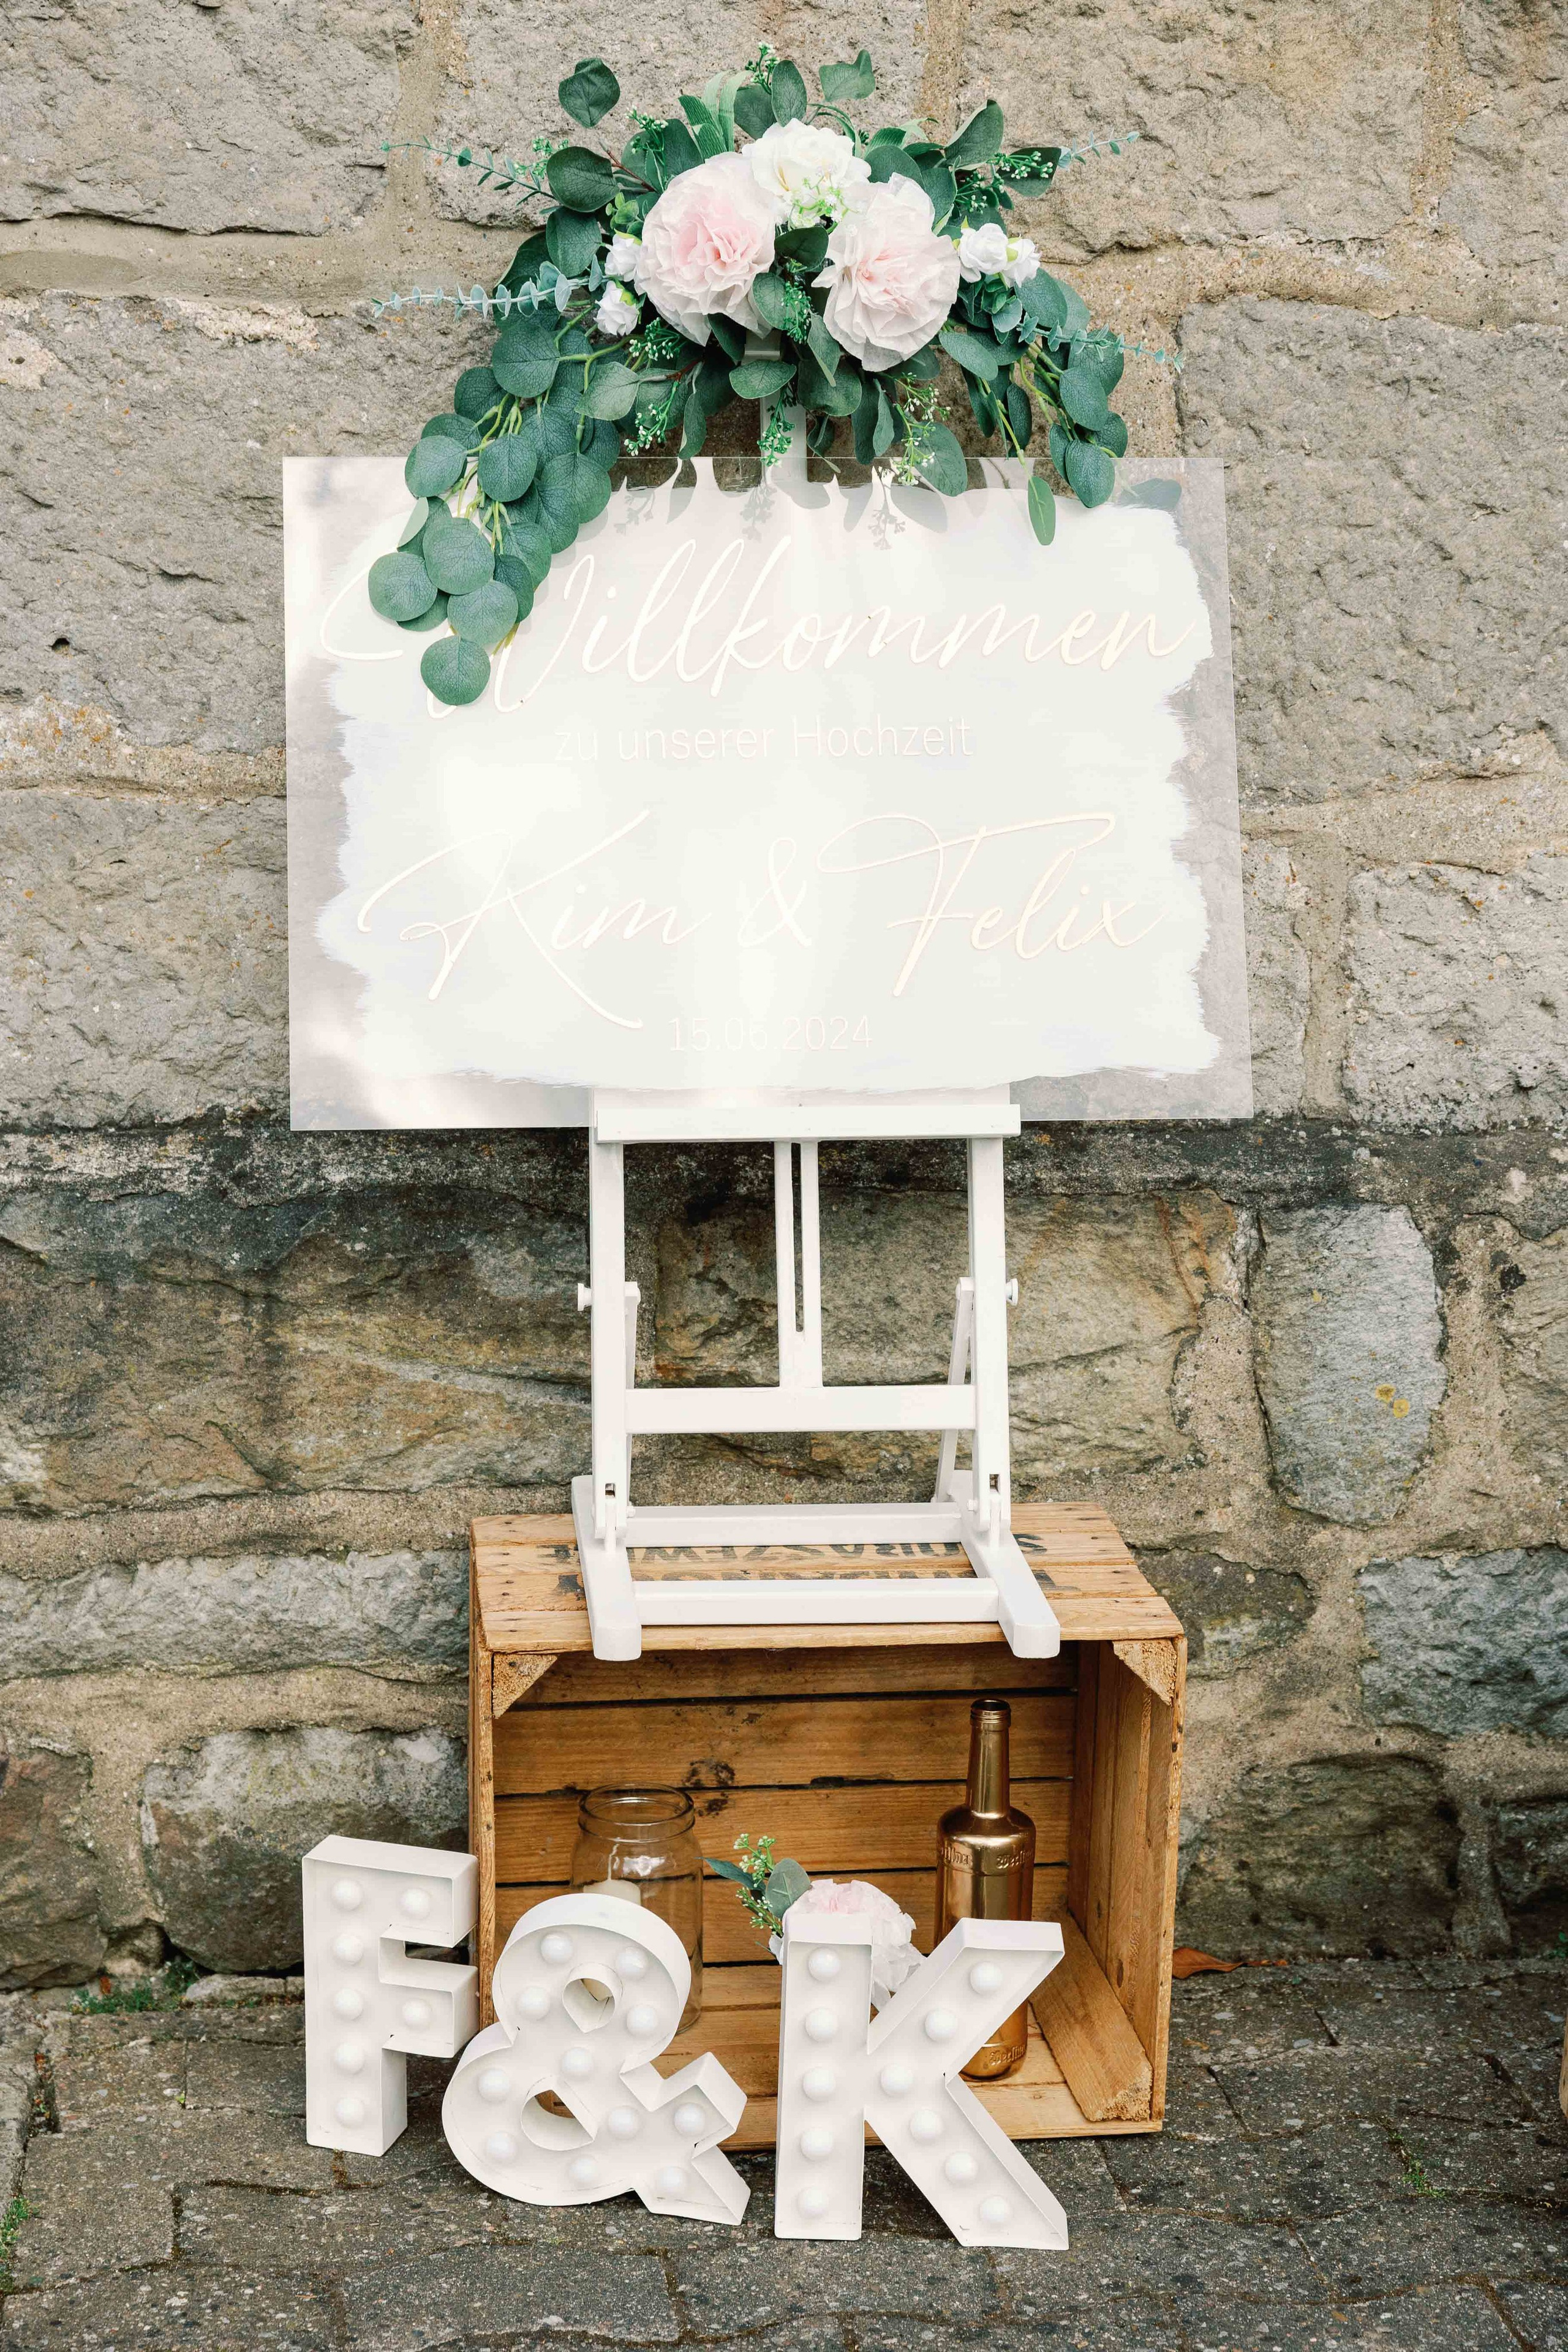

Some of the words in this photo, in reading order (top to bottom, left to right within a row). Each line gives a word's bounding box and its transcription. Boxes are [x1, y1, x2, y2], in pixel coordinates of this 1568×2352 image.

[554, 728, 599, 761] zu
[617, 728, 775, 761] unserer
[790, 713, 975, 758] Hochzeit
[356, 808, 712, 1030] Kim
[737, 837, 813, 949] &
[815, 811, 1167, 998] Felix
[301, 1834, 478, 2156] F
[774, 1912, 1069, 2250] K
